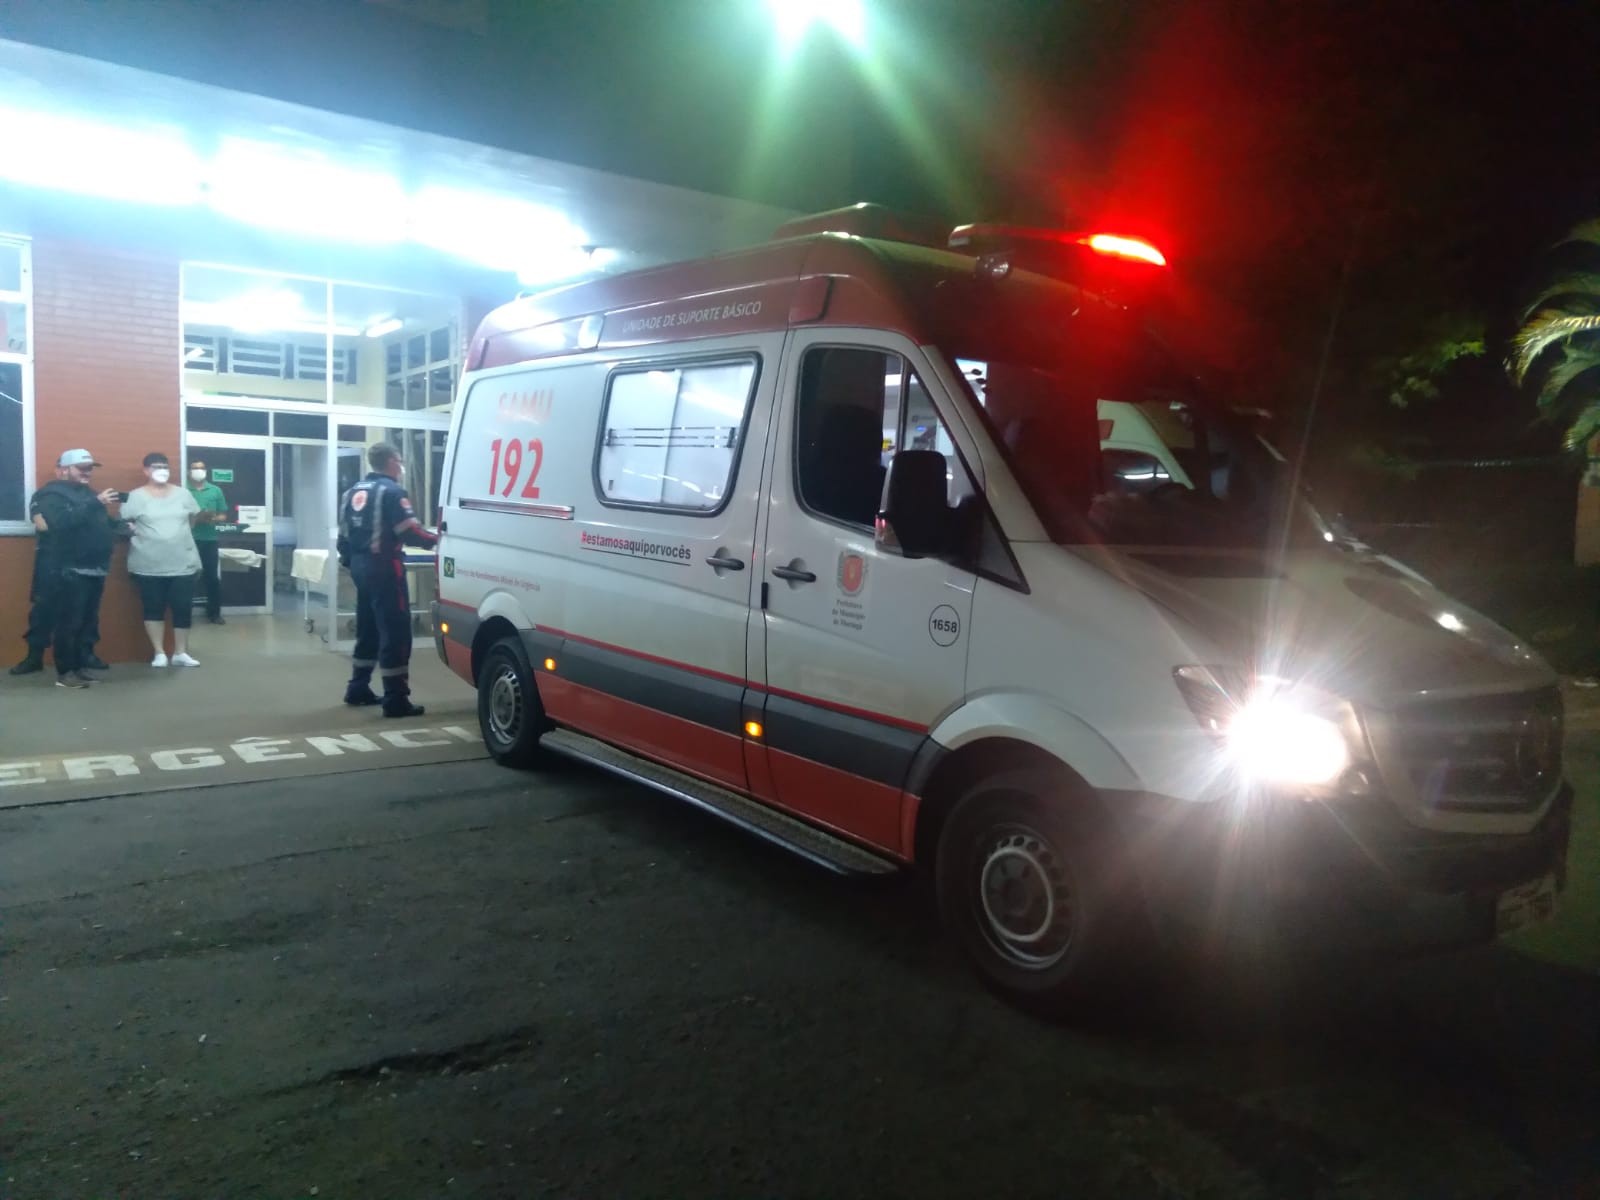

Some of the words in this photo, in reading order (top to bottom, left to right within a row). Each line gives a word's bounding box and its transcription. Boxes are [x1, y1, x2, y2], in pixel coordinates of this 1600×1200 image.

[622, 315, 662, 333] UNDADE
[662, 313, 677, 328] DE
[676, 306, 722, 326] SUPORTE
[721, 300, 762, 319] BÁSICO
[489, 438, 544, 499] 192
[581, 530, 691, 560] #estamosaquiporvocês
[931, 618, 957, 633] 1658
[0, 726, 483, 786] ERGÊNCI
